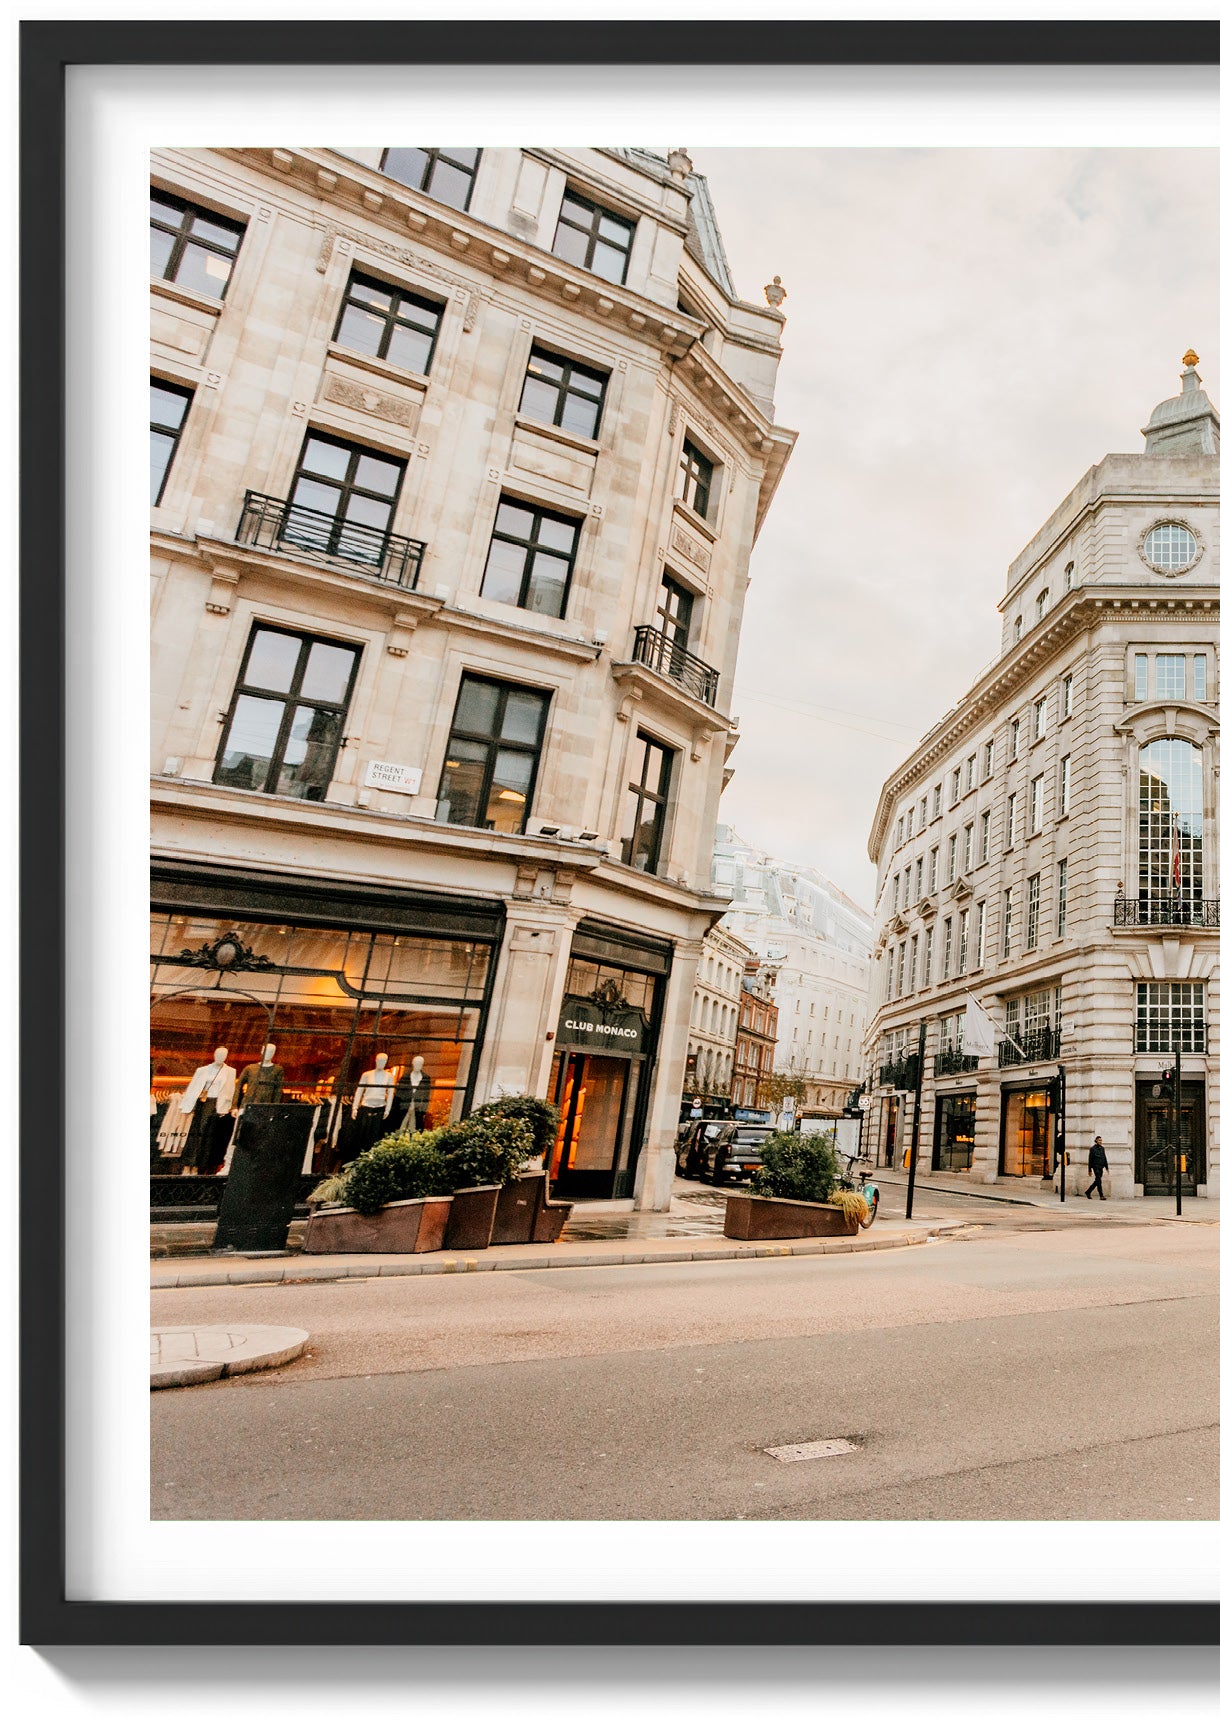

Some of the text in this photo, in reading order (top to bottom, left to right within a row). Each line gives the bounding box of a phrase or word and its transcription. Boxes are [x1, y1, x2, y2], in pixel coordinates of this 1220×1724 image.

[374, 764, 405, 775] REGENT
[372, 772, 401, 783] STREET
[565, 1020, 637, 1038] CLUB MONACO
[1158, 1060, 1184, 1069] Mulby
